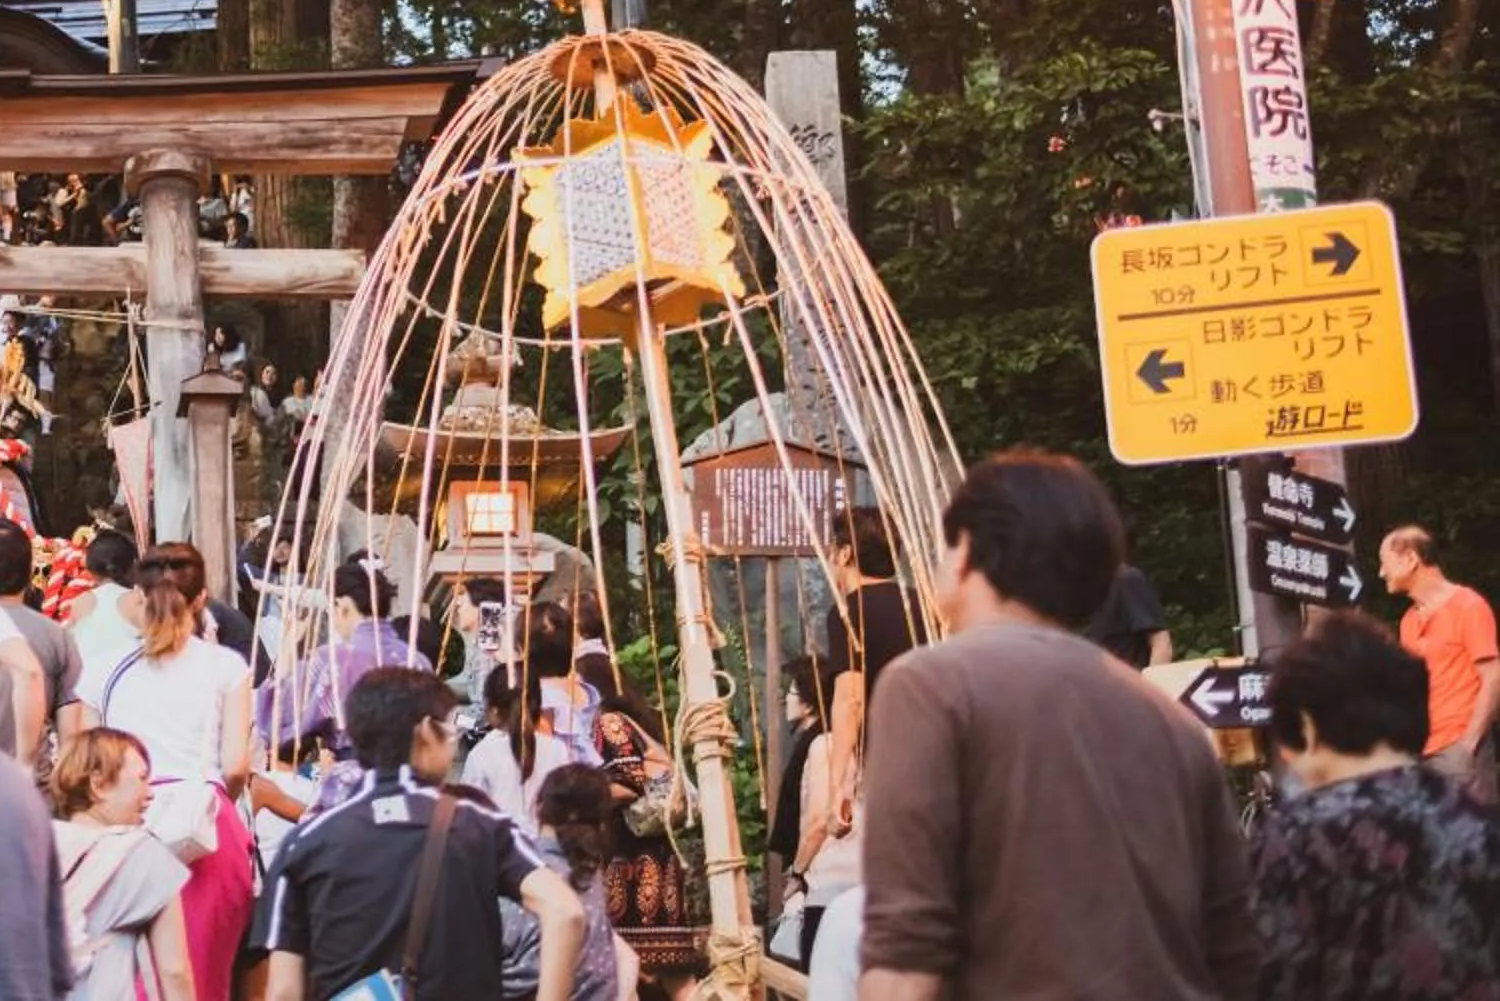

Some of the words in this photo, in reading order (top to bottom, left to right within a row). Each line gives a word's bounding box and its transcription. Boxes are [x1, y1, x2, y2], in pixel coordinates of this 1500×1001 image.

[1210, 262, 1288, 292] リフト
[1151, 284, 1195, 305] 10分
[1294, 332, 1374, 361] リフト
[1211, 370, 1326, 404] 動く歩道
[1169, 413, 1197, 434] 1分
[1265, 400, 1364, 438] 遊ロード
